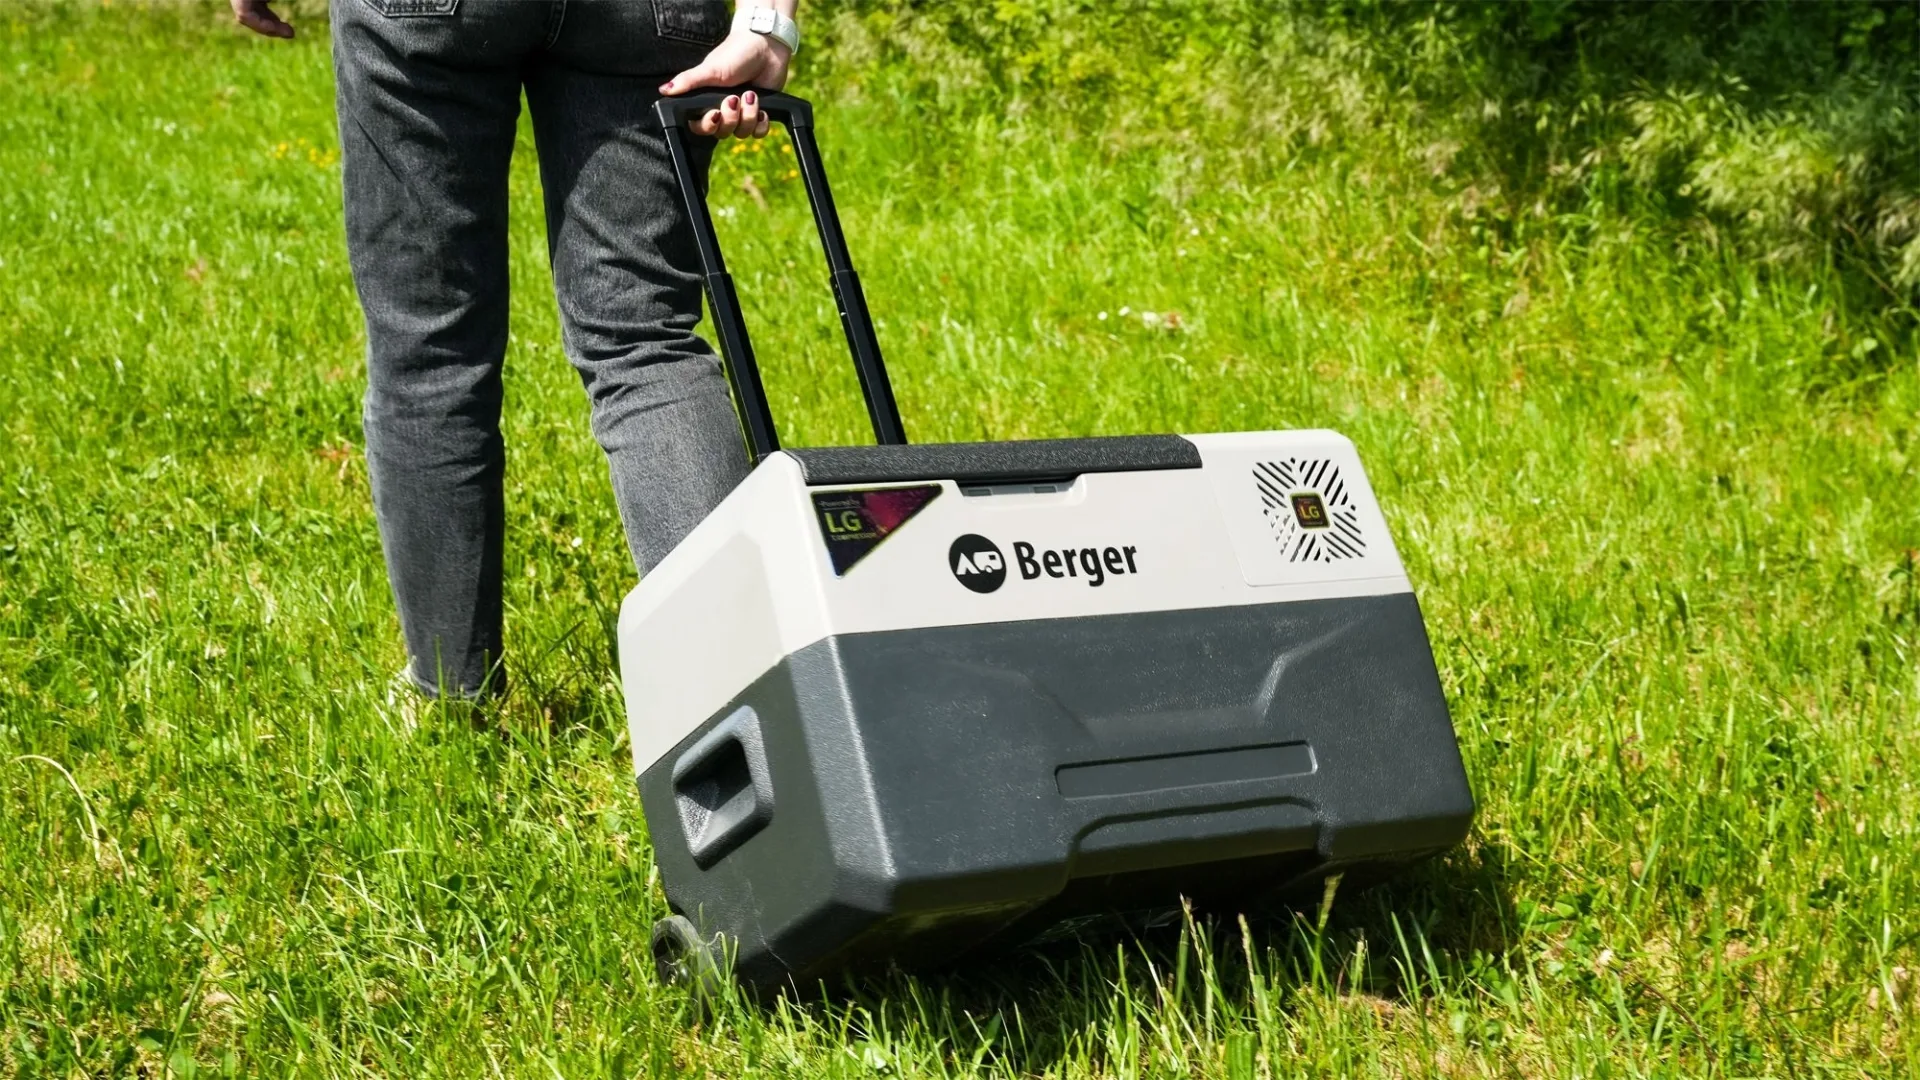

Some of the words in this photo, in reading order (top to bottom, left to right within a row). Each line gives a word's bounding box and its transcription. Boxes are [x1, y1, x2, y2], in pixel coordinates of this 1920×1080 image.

[824, 511, 863, 533] LG
[1300, 505, 1320, 519] LG
[1012, 541, 1138, 588] Berger
